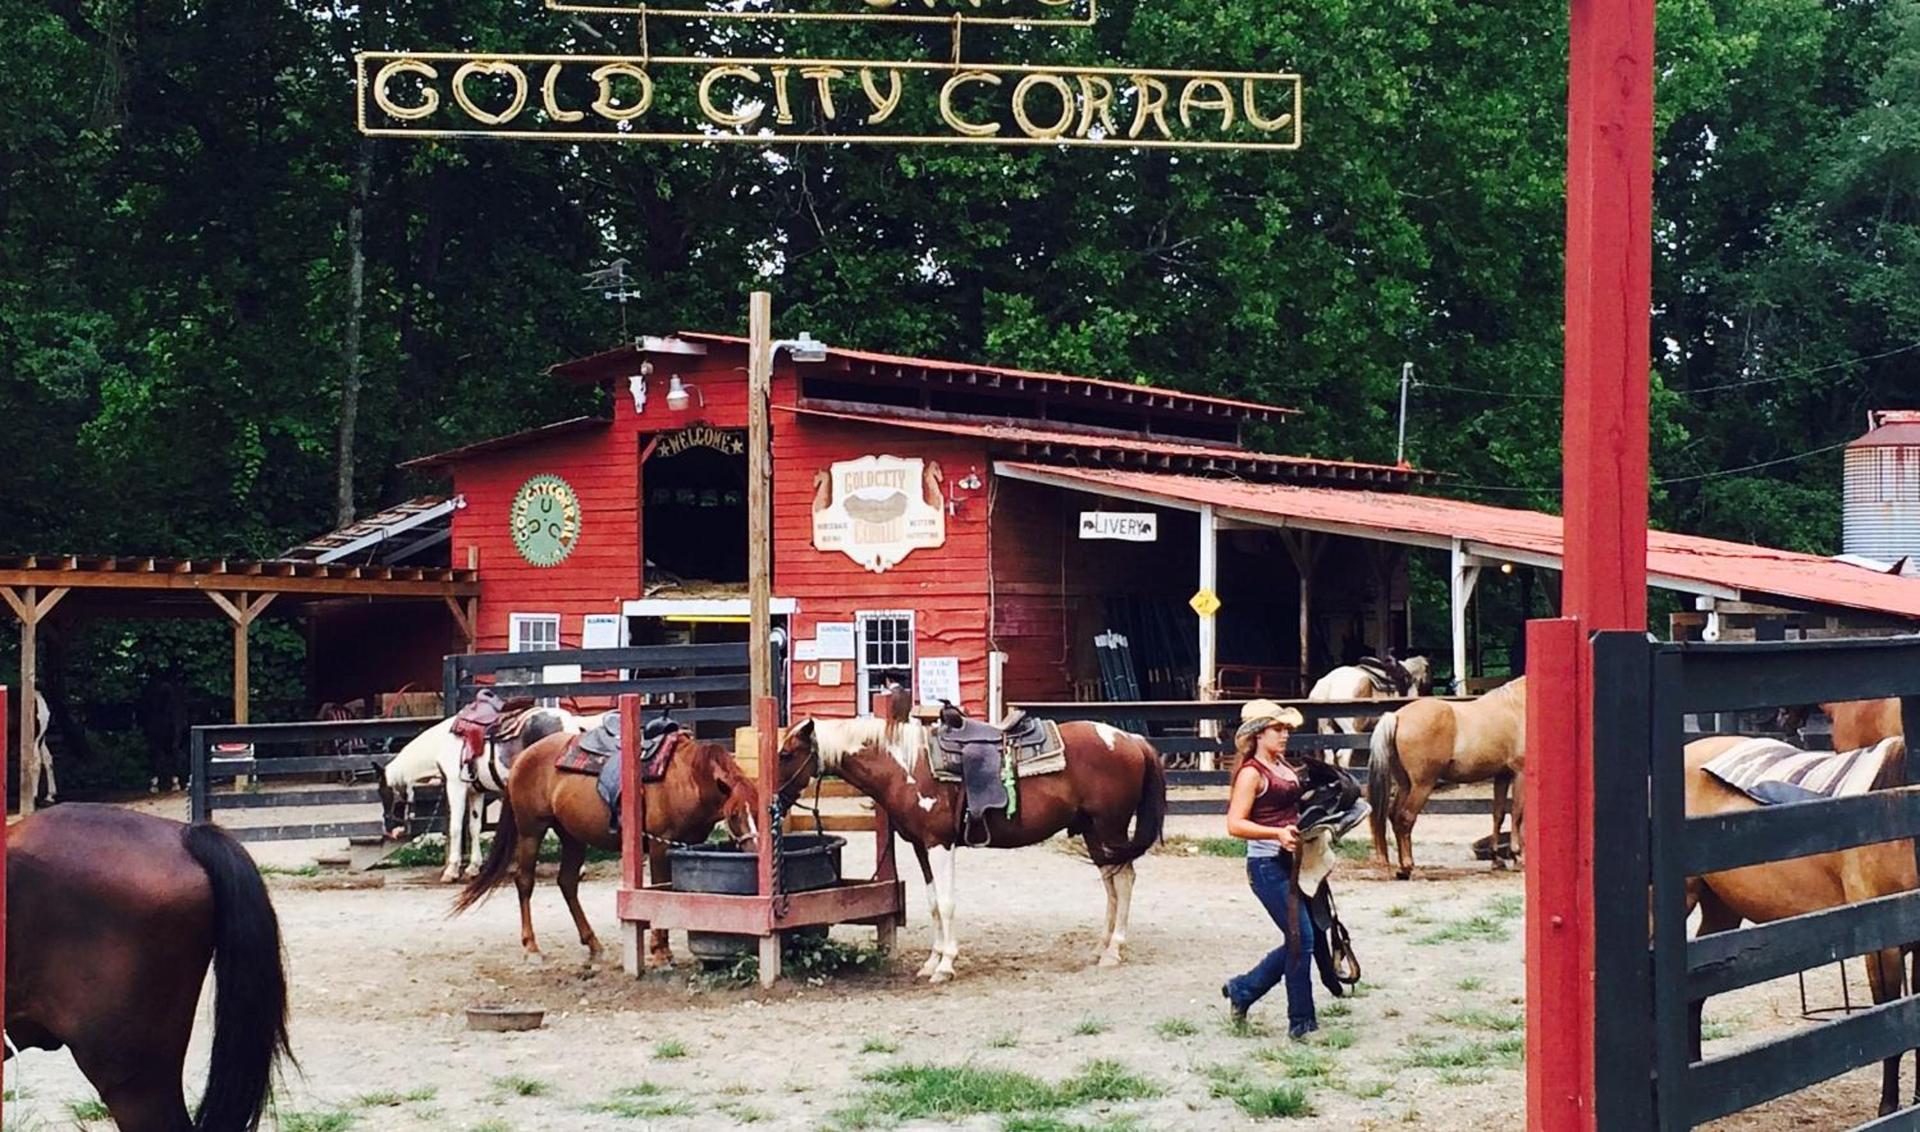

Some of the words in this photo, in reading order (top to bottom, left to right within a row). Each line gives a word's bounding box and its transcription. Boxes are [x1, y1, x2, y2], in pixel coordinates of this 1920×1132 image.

[373, 60, 653, 124] GOLD
[699, 64, 902, 126] CITY
[940, 71, 1292, 139] CORRAL
[668, 427, 730, 455] WELCOME
[516, 499, 529, 541] GOLD
[1095, 513, 1144, 536] LIVERY
